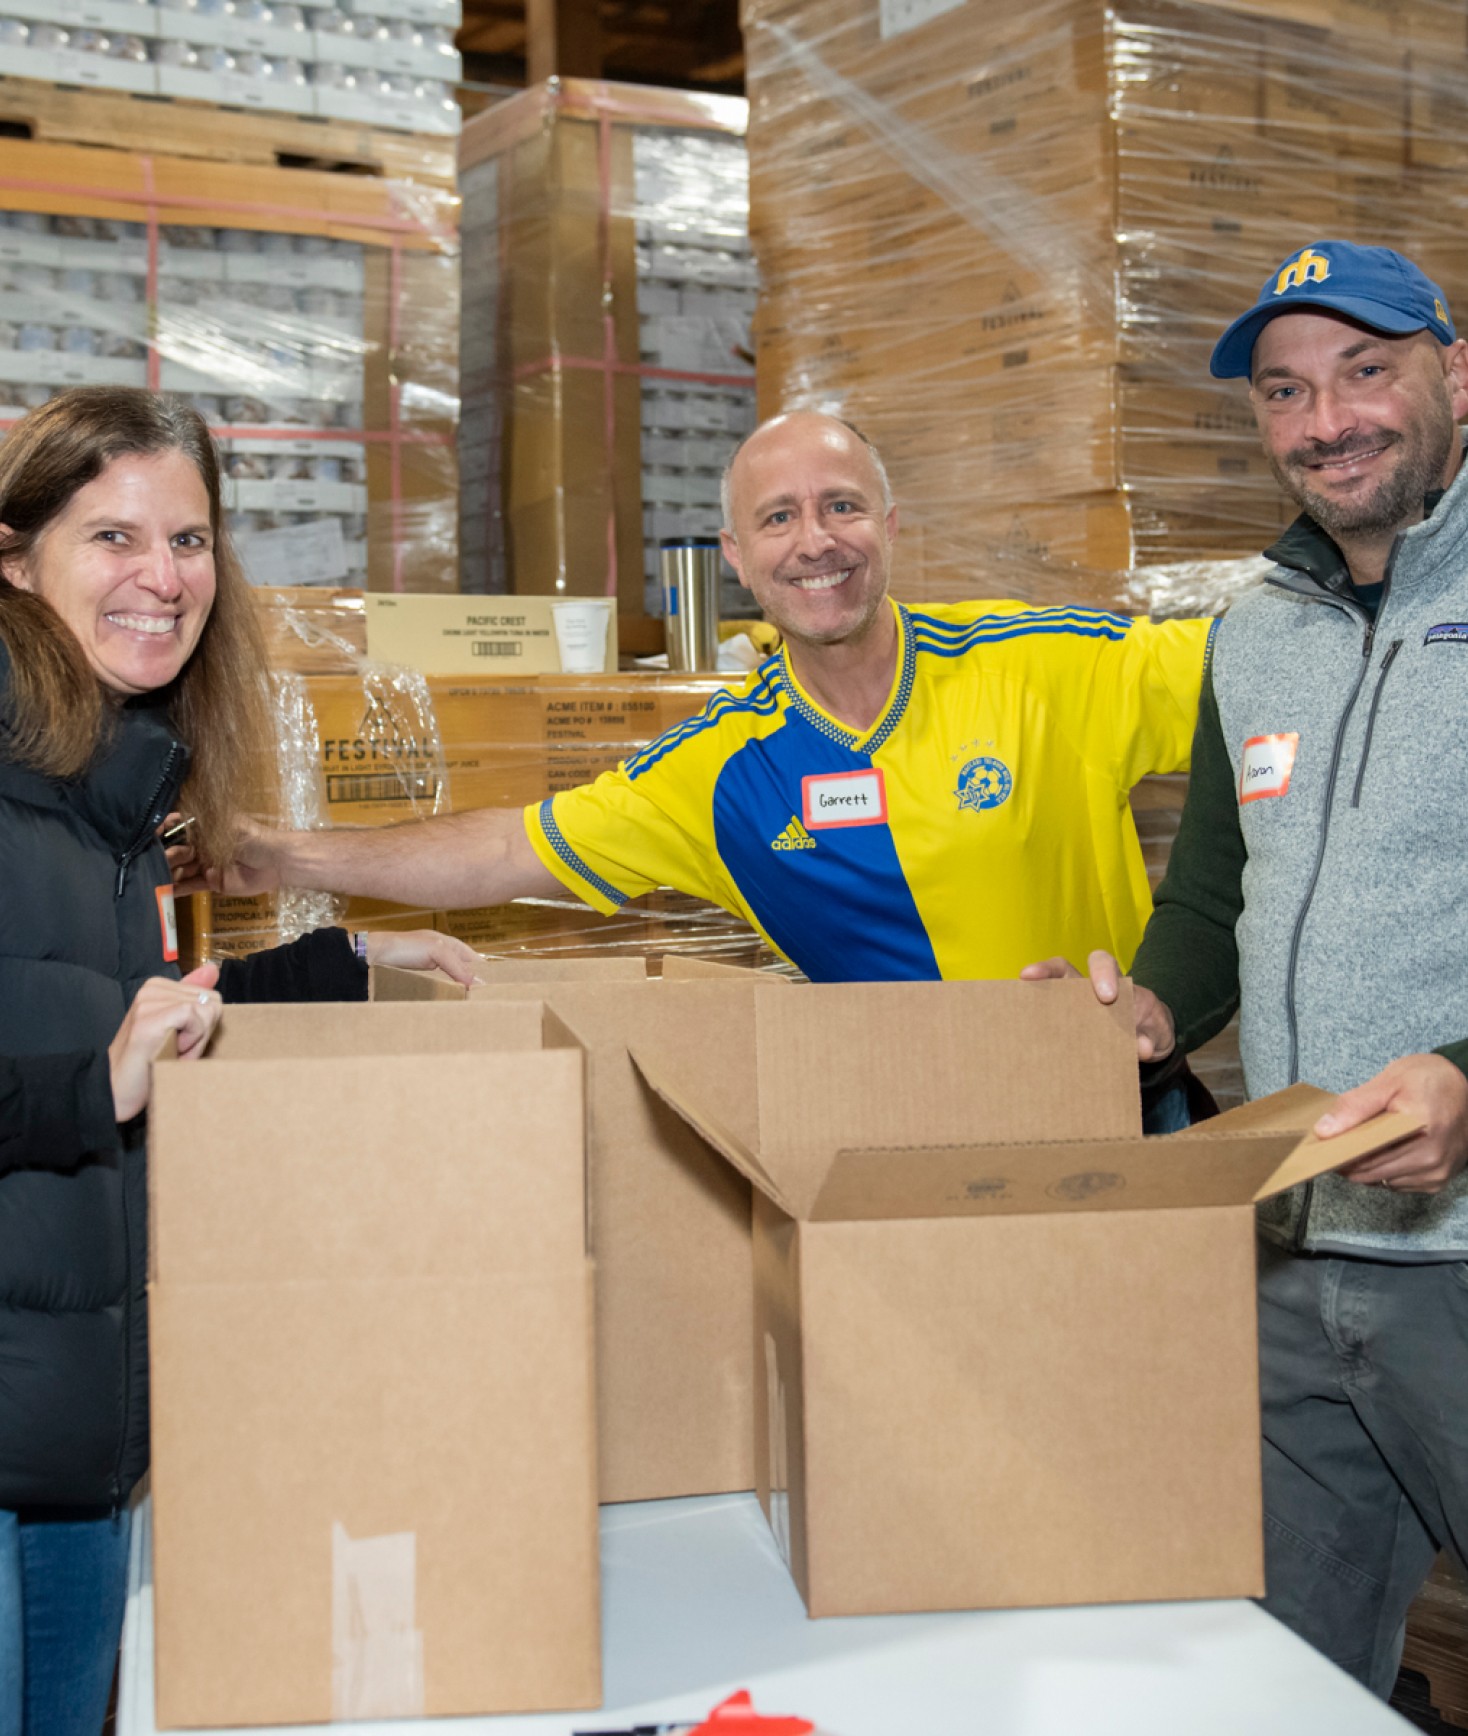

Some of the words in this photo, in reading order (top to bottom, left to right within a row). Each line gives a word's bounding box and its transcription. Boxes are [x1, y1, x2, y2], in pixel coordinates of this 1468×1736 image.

[466, 615, 498, 626] PACIFIC
[500, 615, 526, 626] CREST
[1427, 632, 1467, 642] patagonia
[547, 702, 576, 712] ACME
[580, 702, 604, 712] ITEM
[547, 716, 570, 725] ACME
[573, 716, 585, 724] PO
[547, 730, 586, 739] FESTIVAL
[325, 738, 434, 762] FESTIVAL
[548, 770, 566, 779] CAN
[567, 769, 592, 778] CODE
[819, 792, 869, 808] Garrett
[771, 836, 818, 852] adidas
[213, 911, 264, 922] TROPICAL
[214, 941, 236, 950] CAN
[237, 939, 266, 950] CODE
